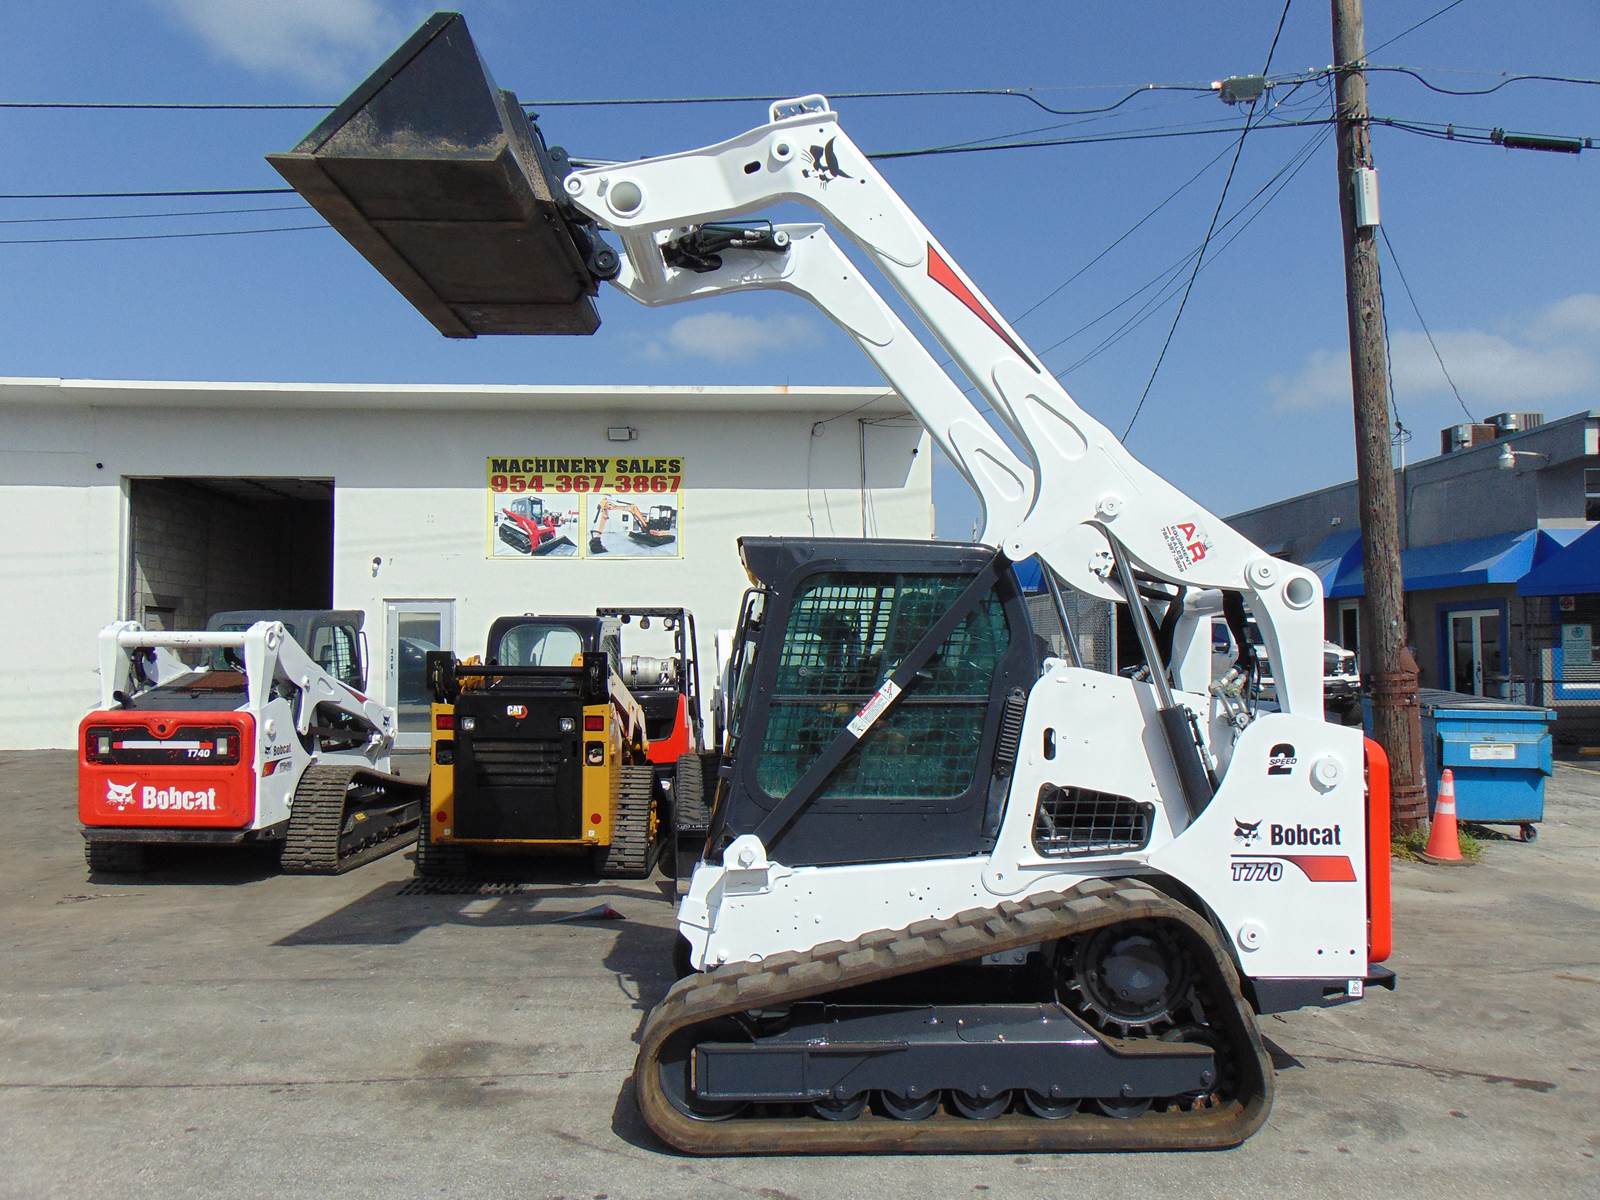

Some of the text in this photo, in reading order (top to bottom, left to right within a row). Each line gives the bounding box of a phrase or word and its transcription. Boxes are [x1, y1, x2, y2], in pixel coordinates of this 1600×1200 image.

[492, 458, 681, 473] MACHINERY SALES
[490, 475, 682, 493] 954-367-3867
[507, 705, 523, 716] CAT
[187, 749, 211, 758] T740
[1268, 743, 1296, 775] 2
[1269, 758, 1298, 767] SPEED
[142, 786, 217, 810] Bobcat
[1270, 823, 1342, 846] Bobcat
[1231, 862, 1284, 882] T770
